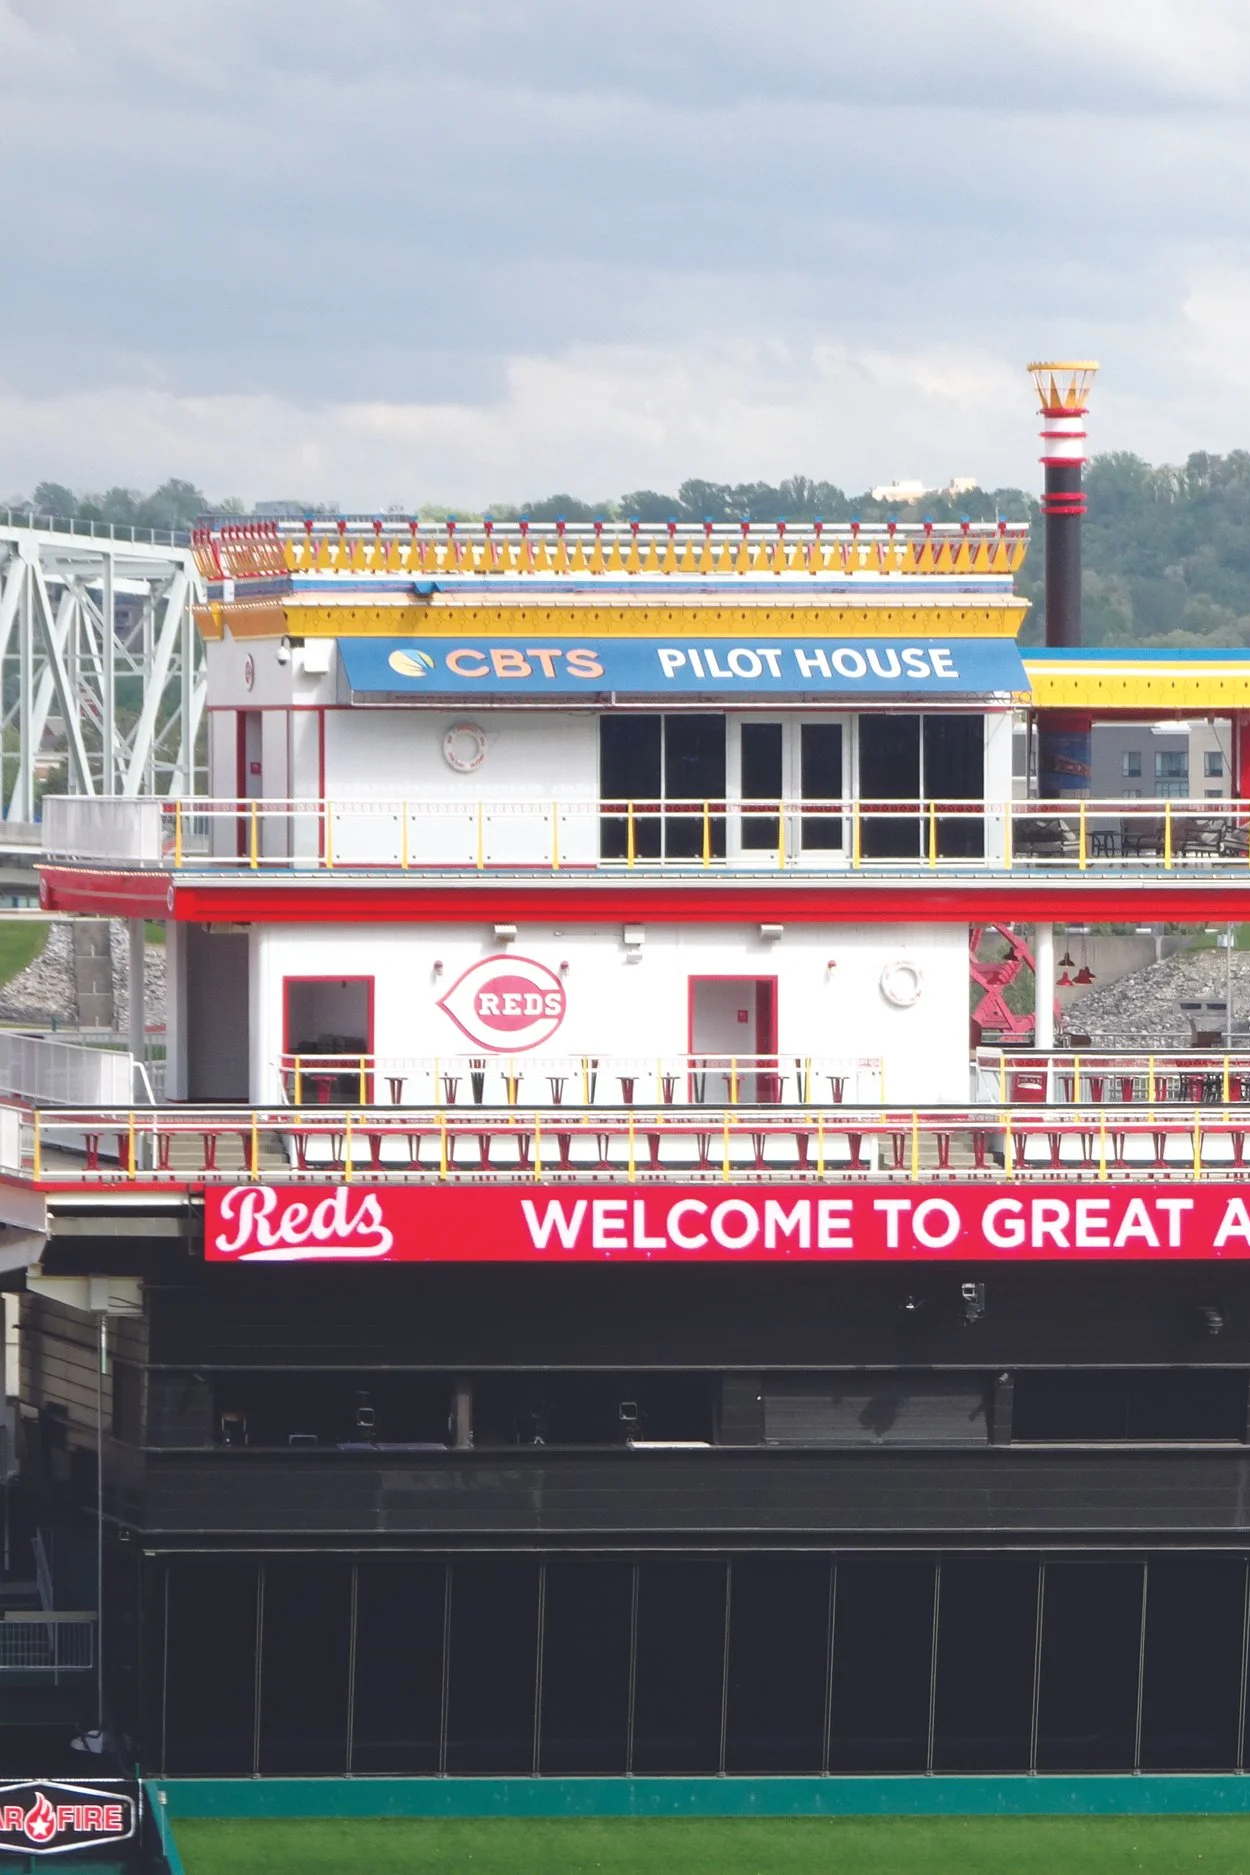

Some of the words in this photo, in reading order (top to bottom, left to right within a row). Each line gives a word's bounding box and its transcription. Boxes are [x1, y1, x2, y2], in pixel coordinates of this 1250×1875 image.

[445, 648, 605, 679] CBTS
[658, 647, 782, 678] PILOT
[795, 648, 959, 680] HOUSE
[478, 992, 562, 1016] REDS
[214, 1185, 395, 1262] Reds
[521, 1198, 853, 1251] WELCOME
[874, 1198, 961, 1249] TO
[981, 1197, 1194, 1249] GREAT
[56, 1804, 123, 1832] FIRE
